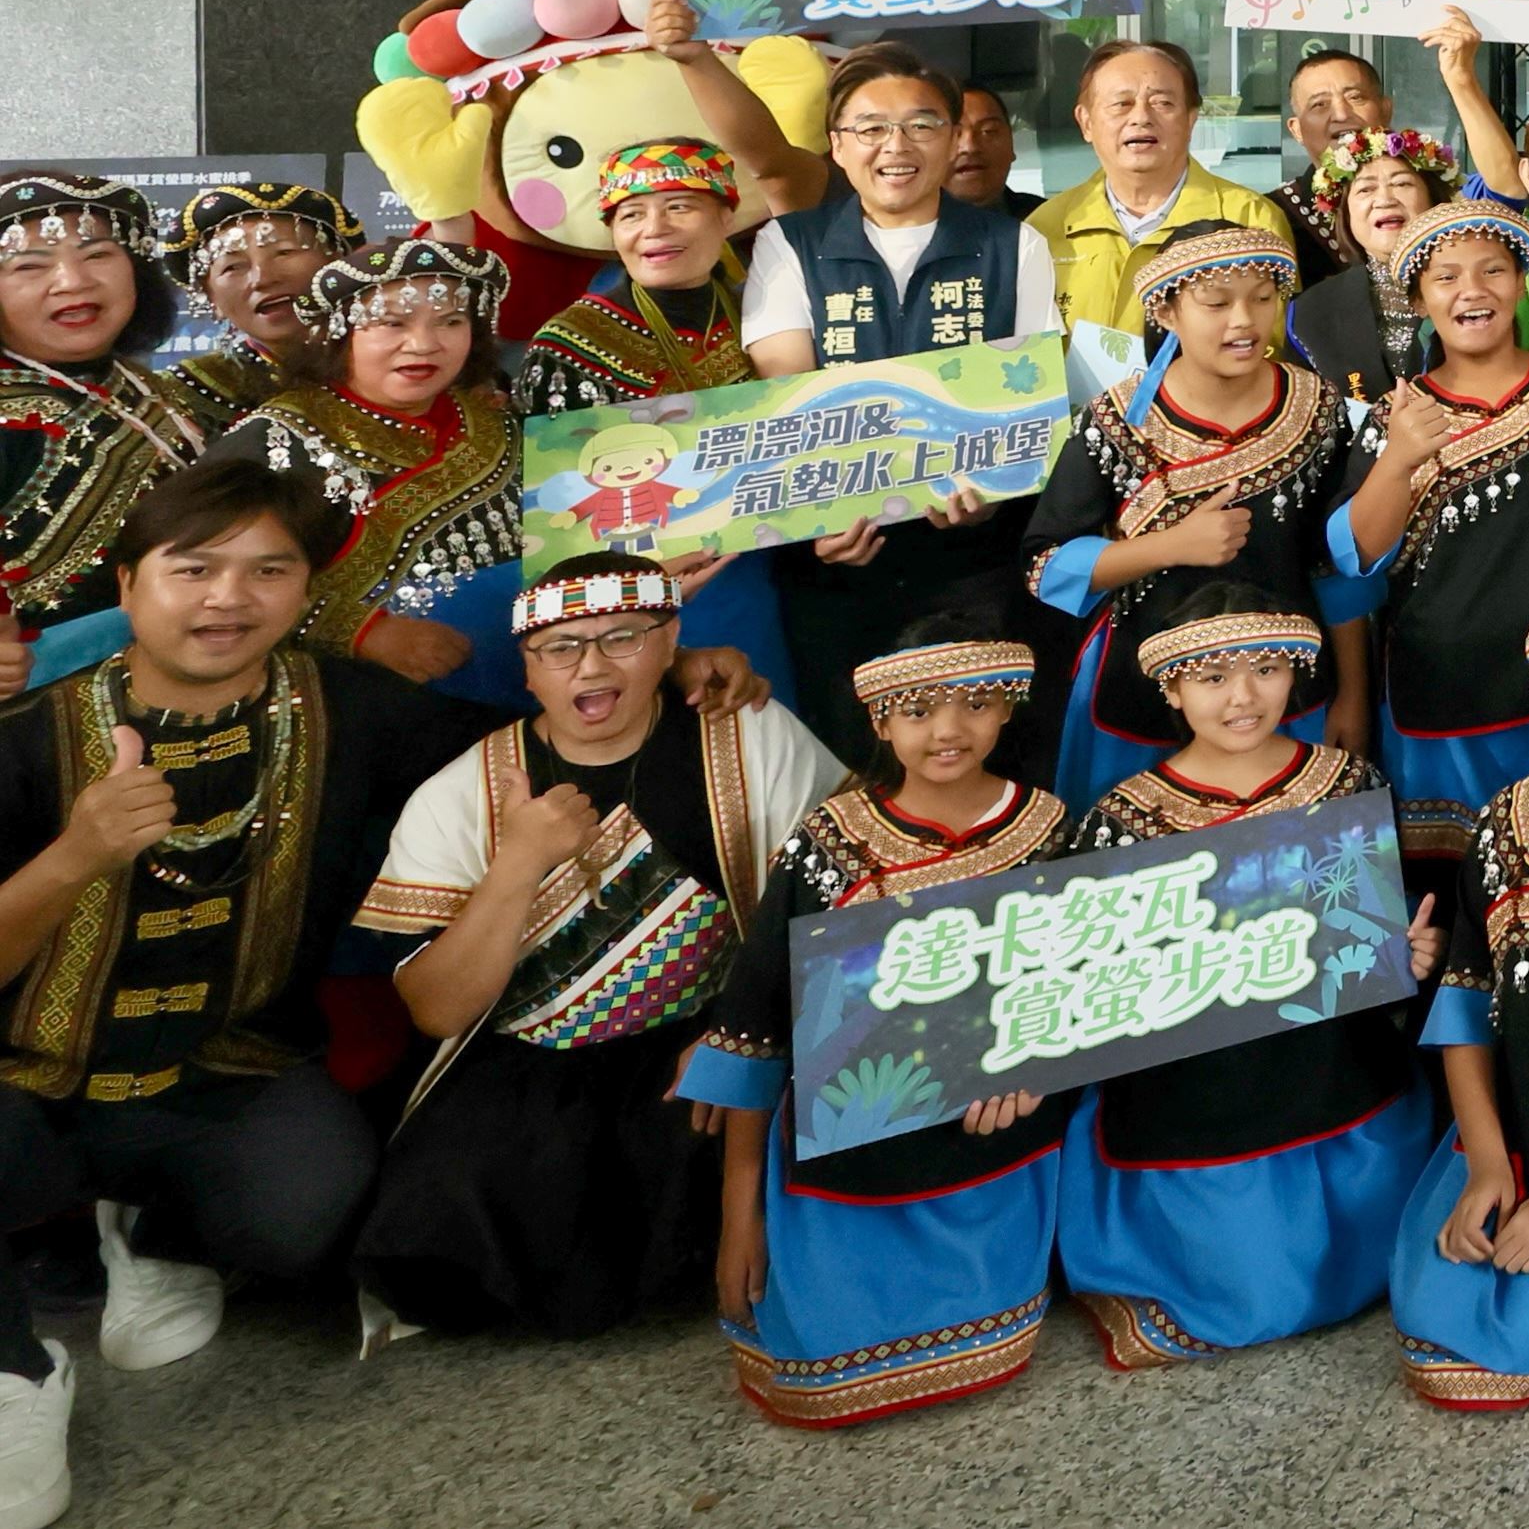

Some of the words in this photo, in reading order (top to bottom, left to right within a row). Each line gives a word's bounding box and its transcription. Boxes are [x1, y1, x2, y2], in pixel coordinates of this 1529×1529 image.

[854, 285, 875, 323] 主任
[930, 280, 966, 344] 柯志
[965, 276, 985, 345] 立法委員
[692, 399, 900, 472] 漂漂河&
[729, 416, 1054, 518] 氣墊水上城堡
[872, 851, 1217, 1009] 達卡努瓦
[983, 909, 1317, 1072] 賞螢步道
